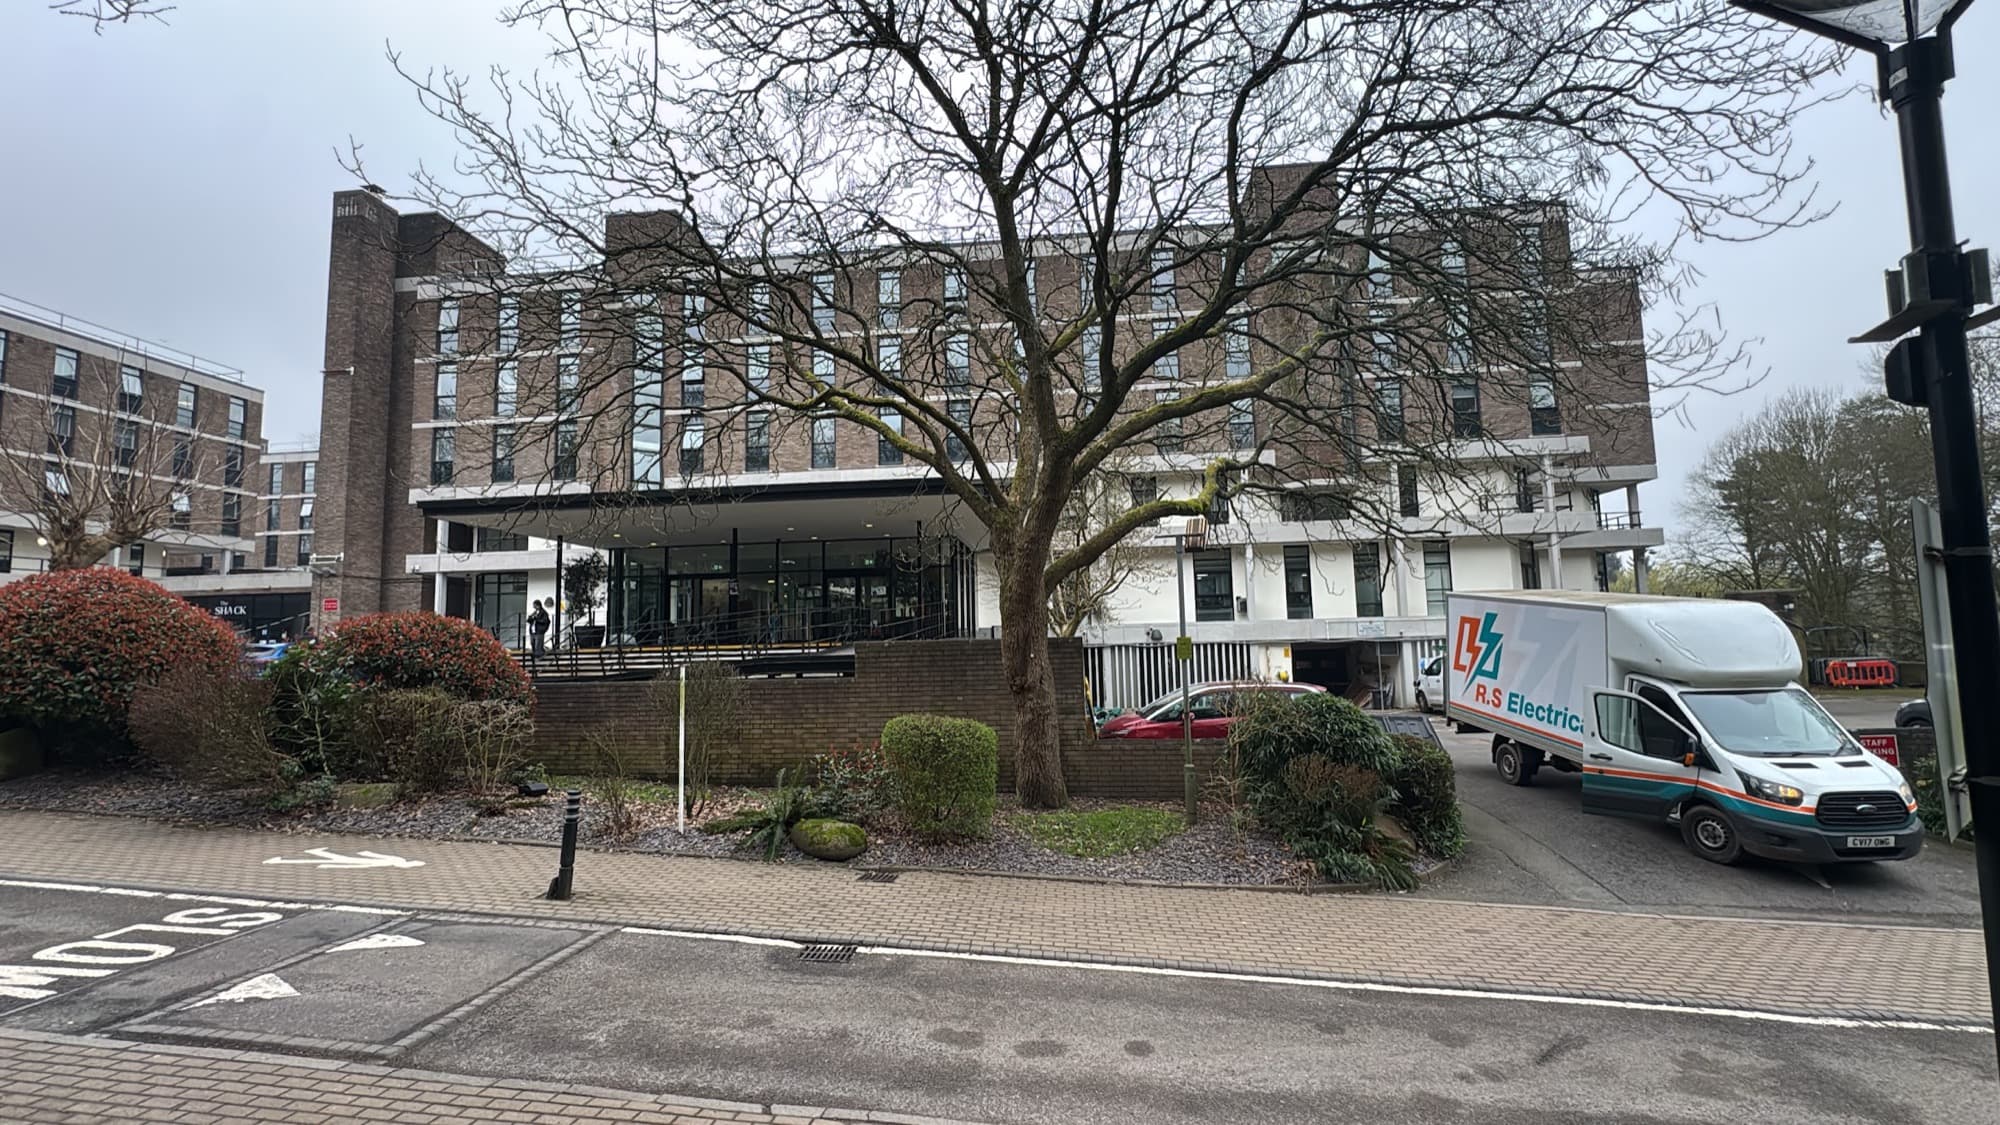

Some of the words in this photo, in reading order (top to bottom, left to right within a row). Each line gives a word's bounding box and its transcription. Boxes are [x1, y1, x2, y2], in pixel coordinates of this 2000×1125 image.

[214, 605, 247, 616] SHACK
[1475, 683, 1503, 708] R.S
[1860, 739, 1888, 747] STAFF
